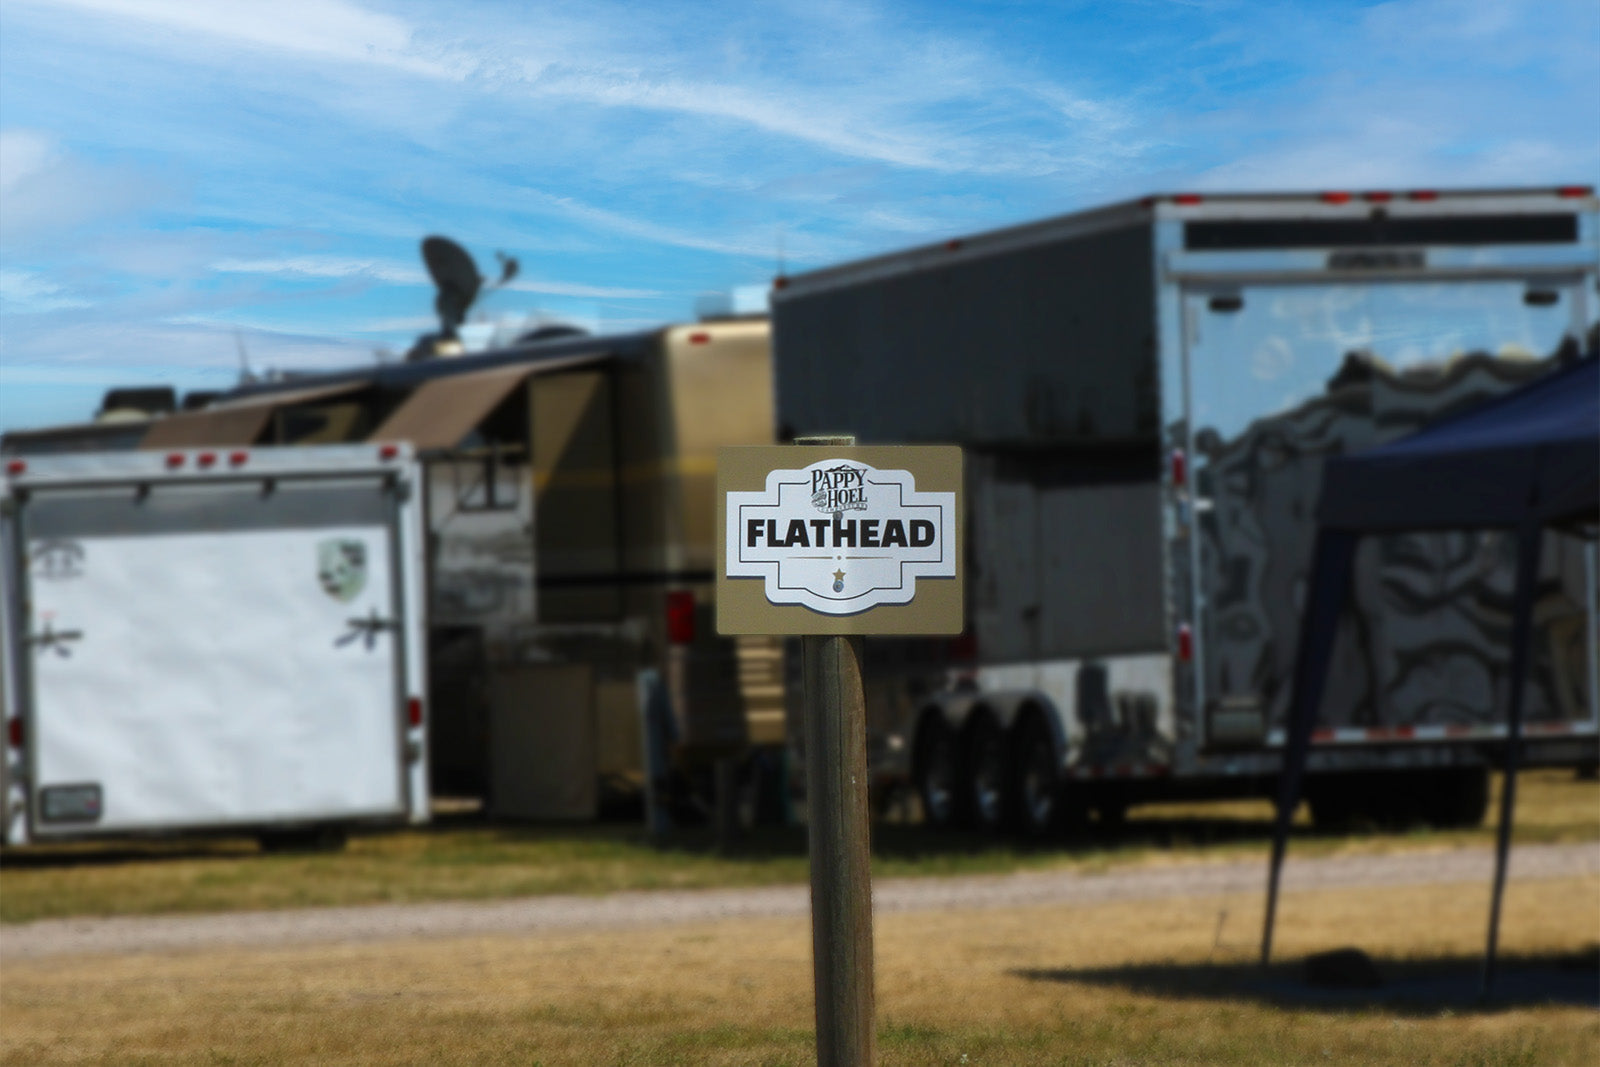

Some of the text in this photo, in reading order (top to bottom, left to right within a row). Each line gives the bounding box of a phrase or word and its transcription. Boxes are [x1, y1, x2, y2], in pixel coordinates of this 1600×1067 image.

[811, 469, 868, 496] PAPPY
[827, 487, 868, 508] HOEL
[747, 519, 935, 547] FLATHEAD
